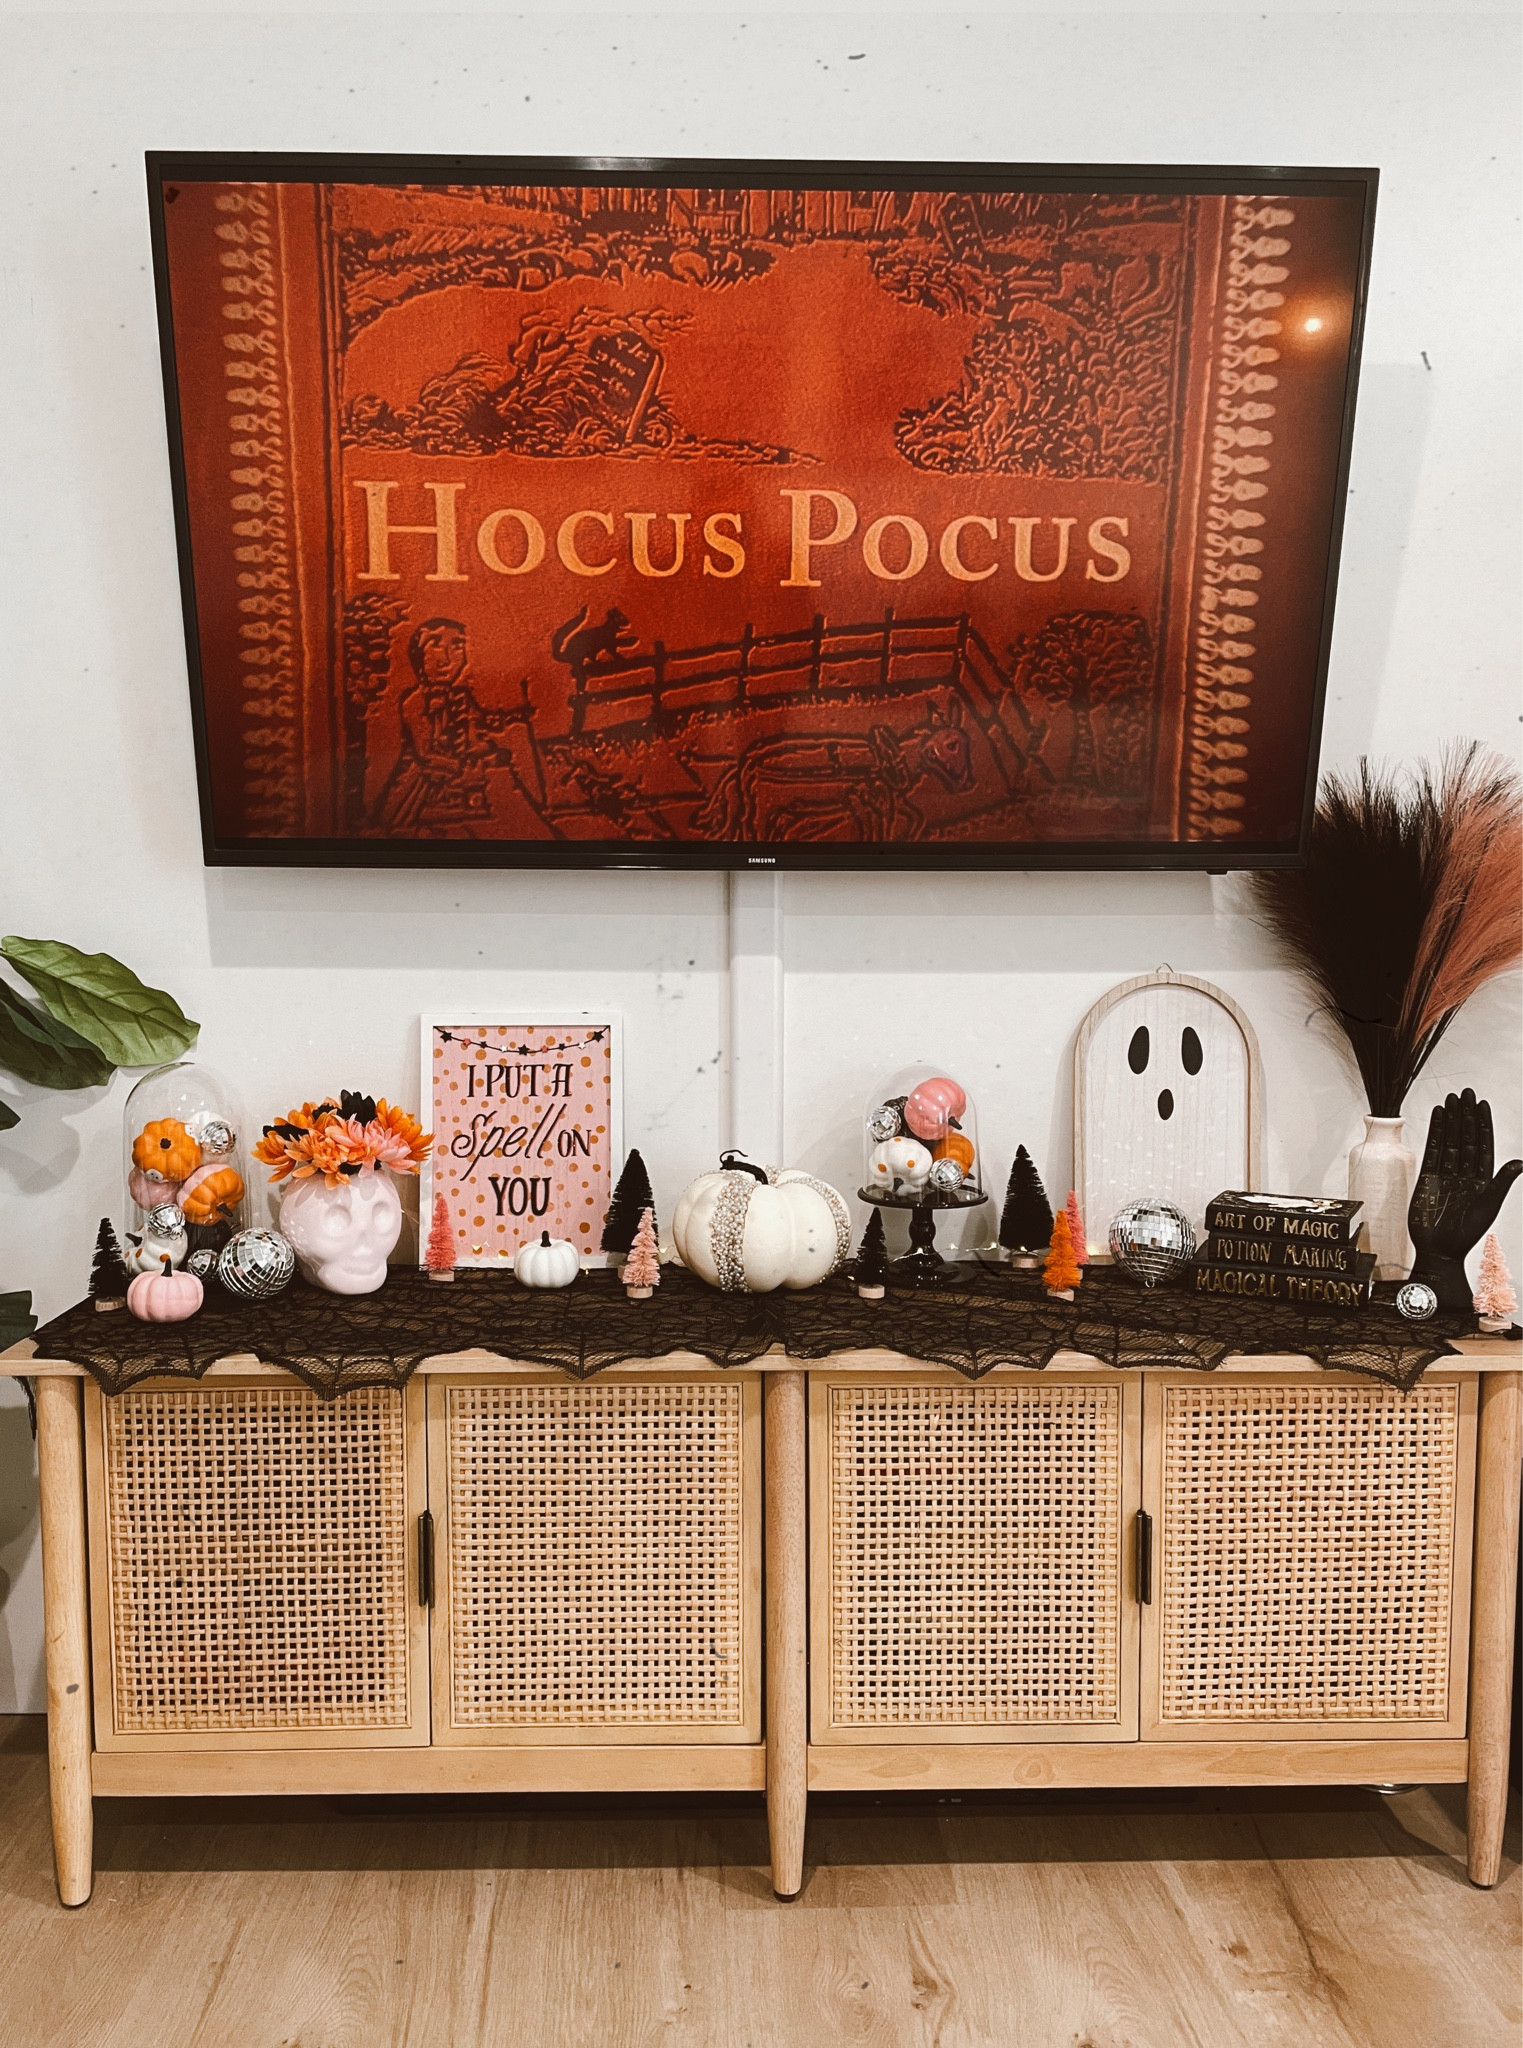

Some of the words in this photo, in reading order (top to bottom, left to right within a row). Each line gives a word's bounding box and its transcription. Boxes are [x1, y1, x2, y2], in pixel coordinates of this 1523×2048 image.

[467, 1064, 477, 1098] I
[485, 1064, 545, 1098] PUT
[551, 1063, 574, 1097] A
[451, 1103, 567, 1181] Spell
[557, 1129, 592, 1157] ON
[488, 1176, 552, 1216] YOU
[1214, 1211, 1246, 1229] ART
[1253, 1215, 1276, 1232] OF
[1283, 1217, 1340, 1240] MAGIC
[1216, 1238, 1272, 1264] POTION
[1283, 1244, 1348, 1271] MAKING
[1195, 1268, 1281, 1298] MAGICAL
[1286, 1275, 1364, 1307] THEORY
